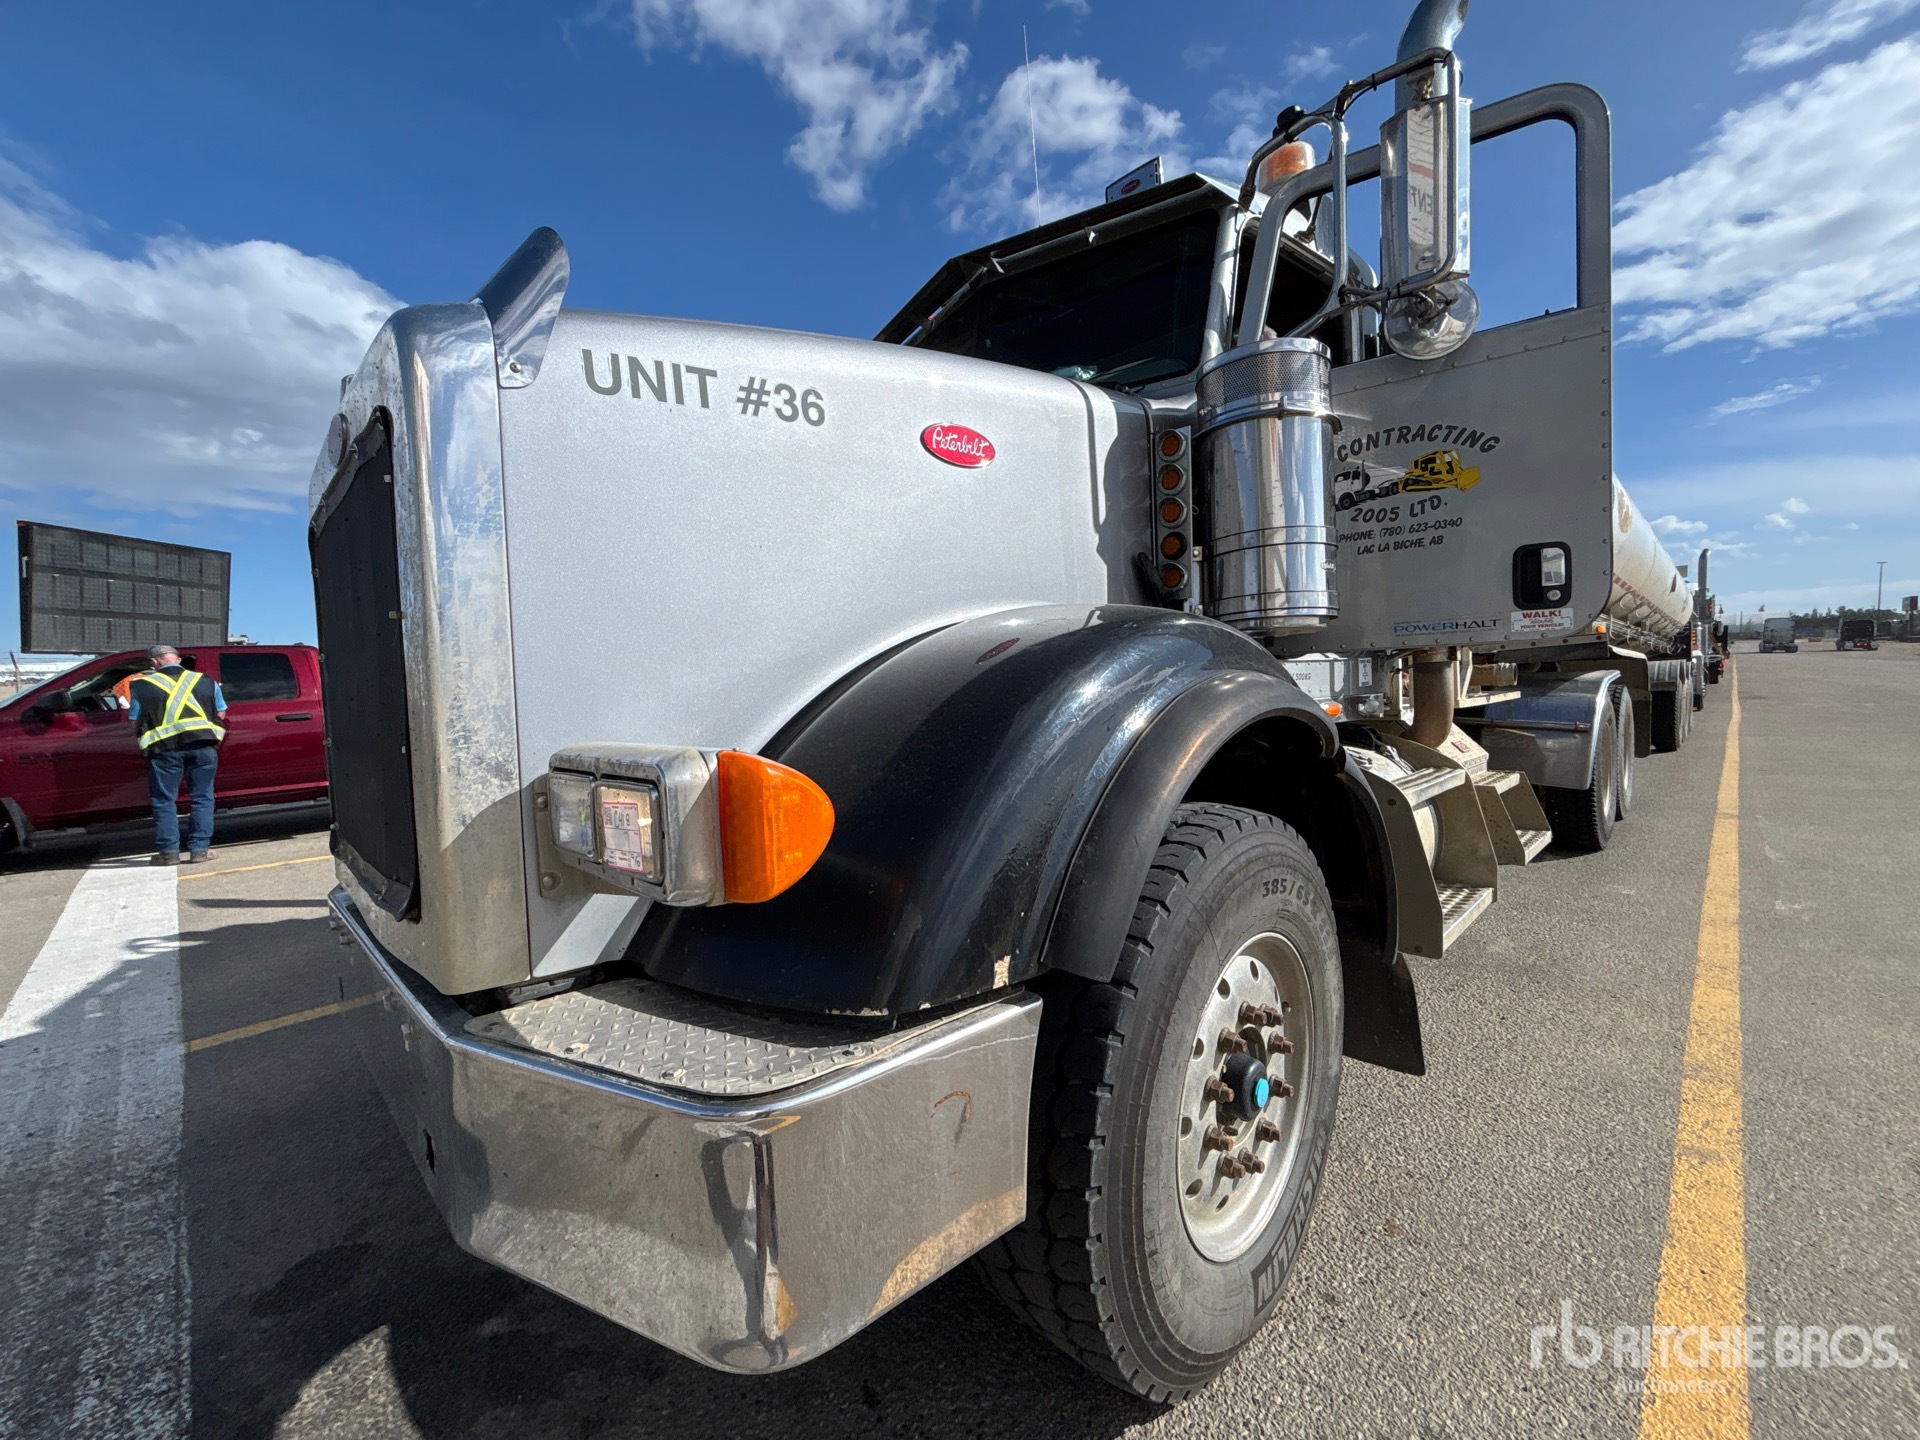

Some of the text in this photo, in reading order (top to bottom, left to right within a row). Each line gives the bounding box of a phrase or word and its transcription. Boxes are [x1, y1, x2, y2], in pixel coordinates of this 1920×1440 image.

[582, 349, 826, 427] UNIT #36
[932, 426, 989, 457] Peterbilt
[1337, 424, 1500, 462] CONTRACTING
[1350, 494, 1448, 523] 2005 LTD.
[1338, 517, 1463, 543] PHONE: (780) 623-0340
[1357, 535, 1444, 555] LAC LA BICHE, AB
[1393, 618, 1502, 633] POWERHALT
[1522, 610, 1561, 619] WALK!
